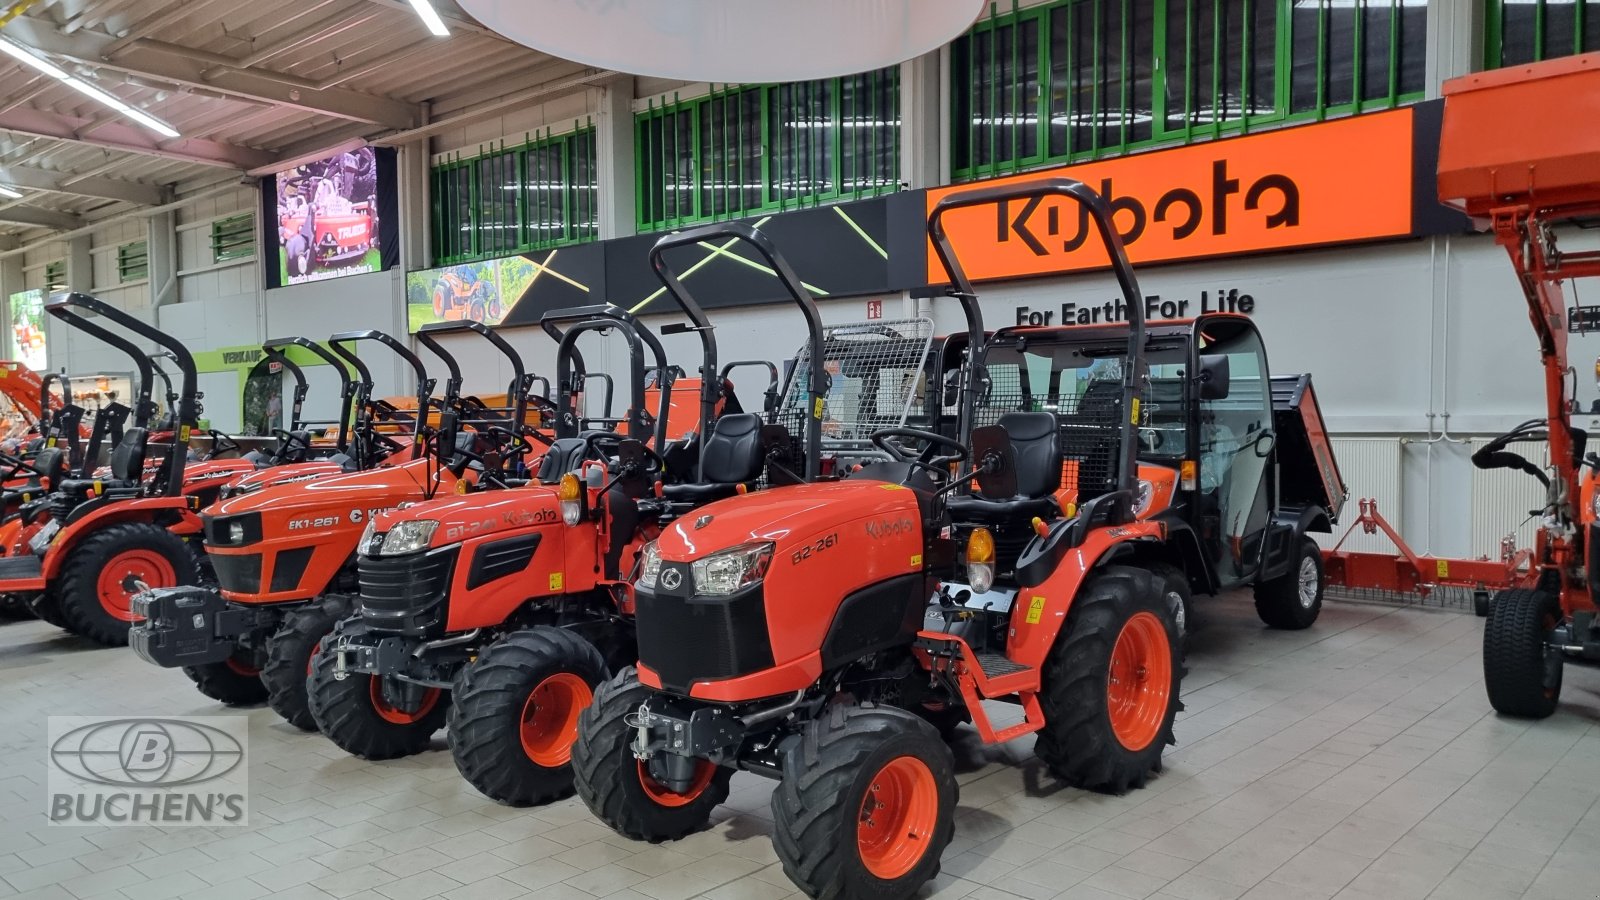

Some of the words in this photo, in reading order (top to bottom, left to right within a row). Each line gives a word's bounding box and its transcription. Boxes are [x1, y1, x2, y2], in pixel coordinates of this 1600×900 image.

[997, 159, 1300, 257] Kubota
[1016, 306, 1053, 326] For
[1061, 298, 1129, 326] Earth
[1145, 295, 1188, 319] For
[1201, 288, 1256, 314] Life
[223, 350, 262, 364] VERKAUF
[288, 516, 340, 530] EK1-261
[865, 518, 913, 540] Kubota
[792, 533, 839, 566] B2-261
